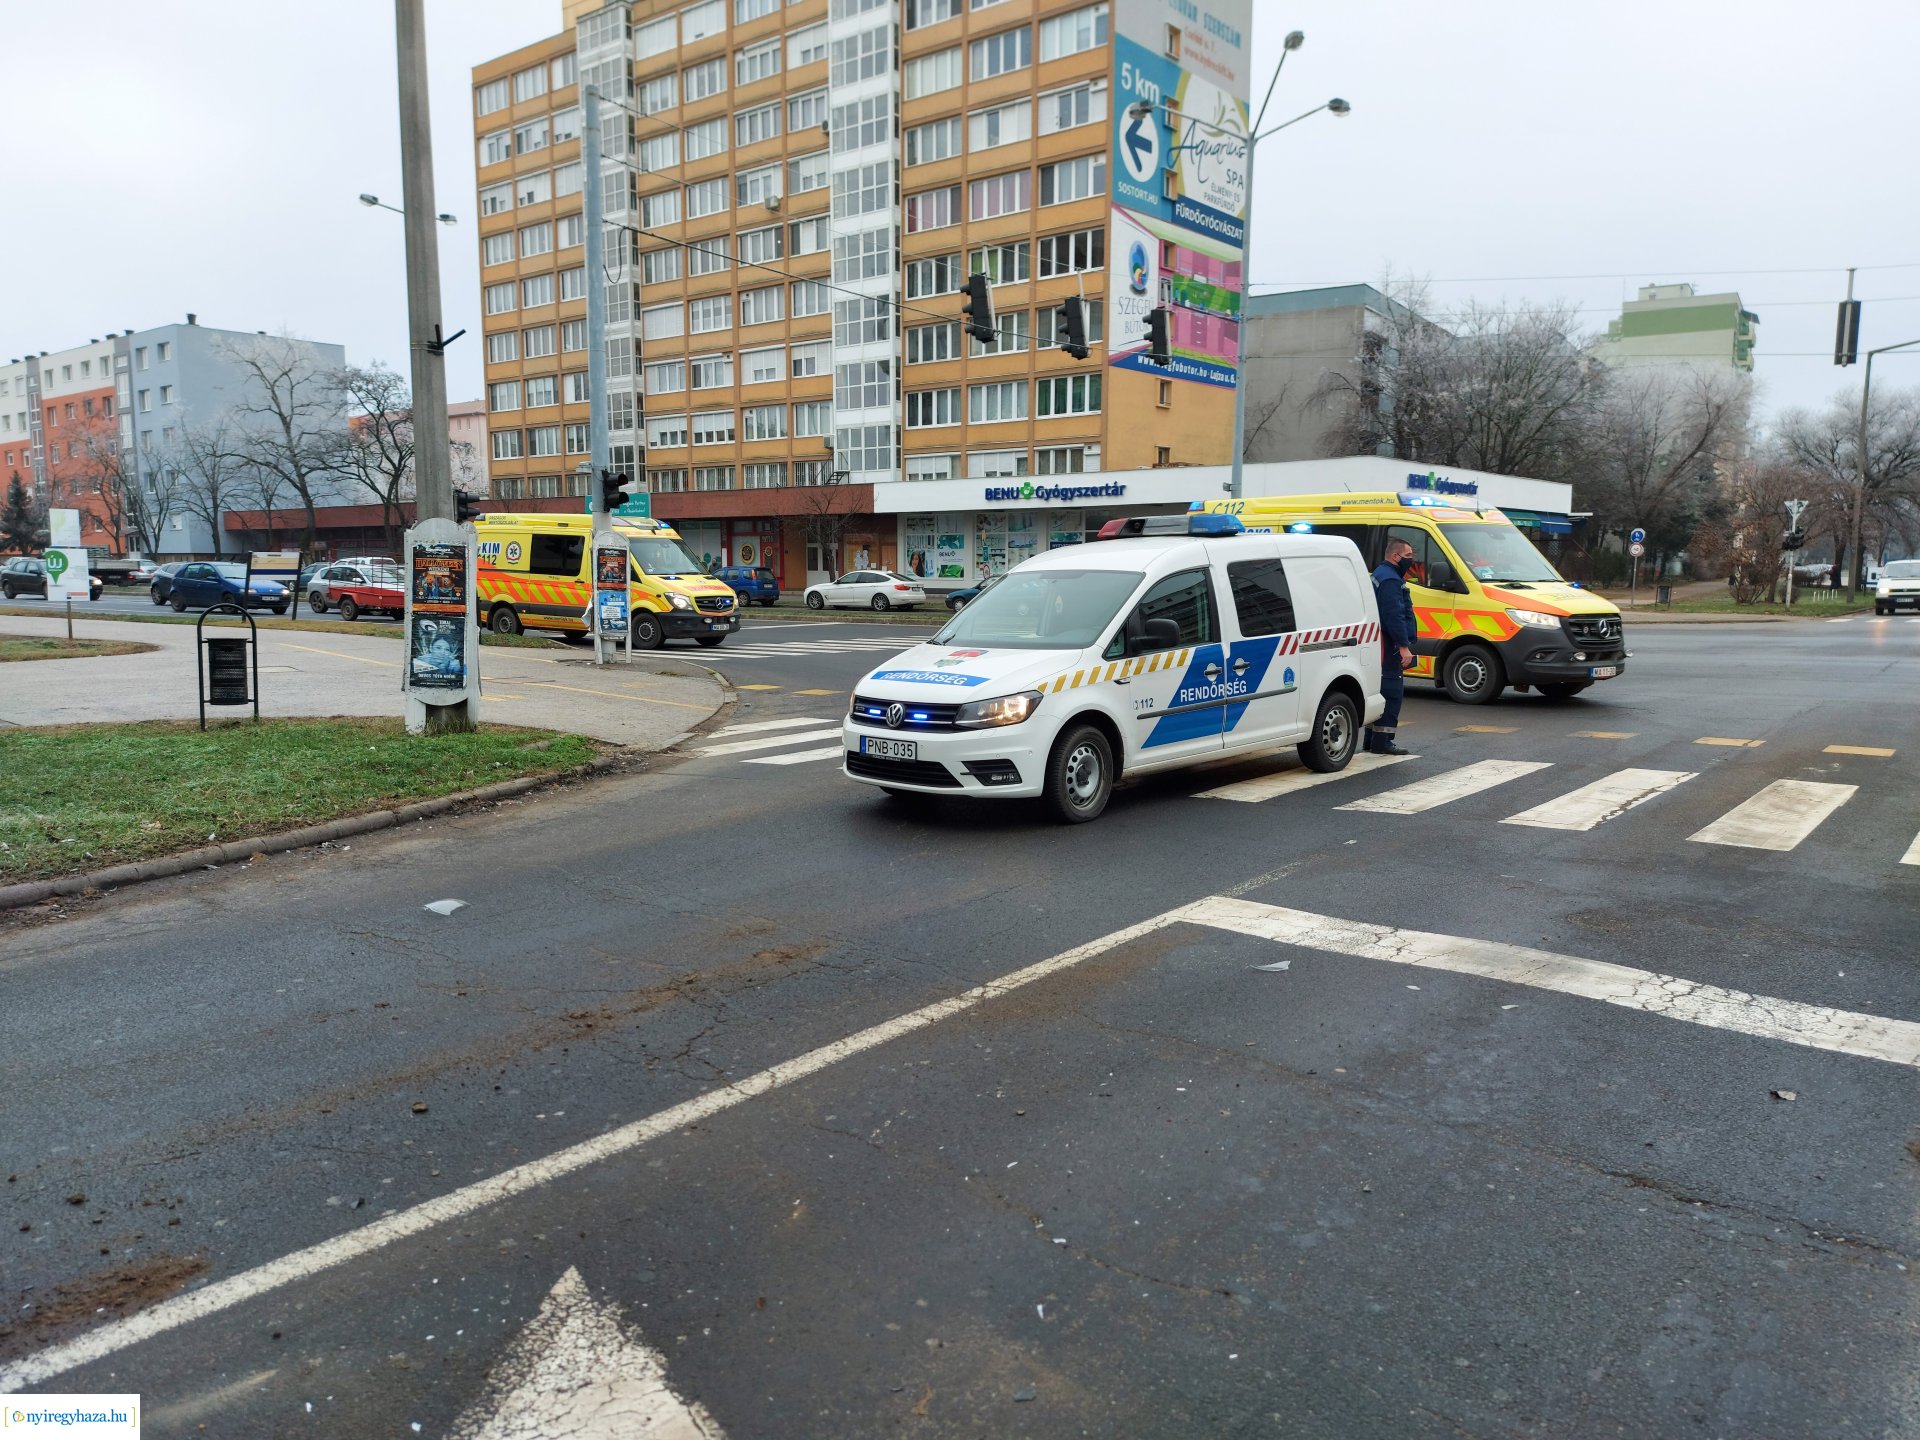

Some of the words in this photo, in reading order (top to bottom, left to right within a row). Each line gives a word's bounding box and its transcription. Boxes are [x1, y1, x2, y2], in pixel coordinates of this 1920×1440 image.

[1121, 61, 1132, 90] 5
[1135, 67, 1159, 106] km
[1166, 118, 1247, 184] Aquarius
[1226, 168, 1244, 190] SPA
[984, 487, 1020, 501] BENU
[1035, 480, 1126, 501] Gyógyszertár
[1224, 501, 1245, 516] 112
[47, 554, 63, 569] ÚJ
[482, 554, 497, 566] 112
[880, 671, 968, 686] RENDŐRSÉG
[1180, 678, 1247, 703] RENDŐRSÉG
[1140, 697, 1154, 709] 112
[867, 739, 913, 758] PNB-035
